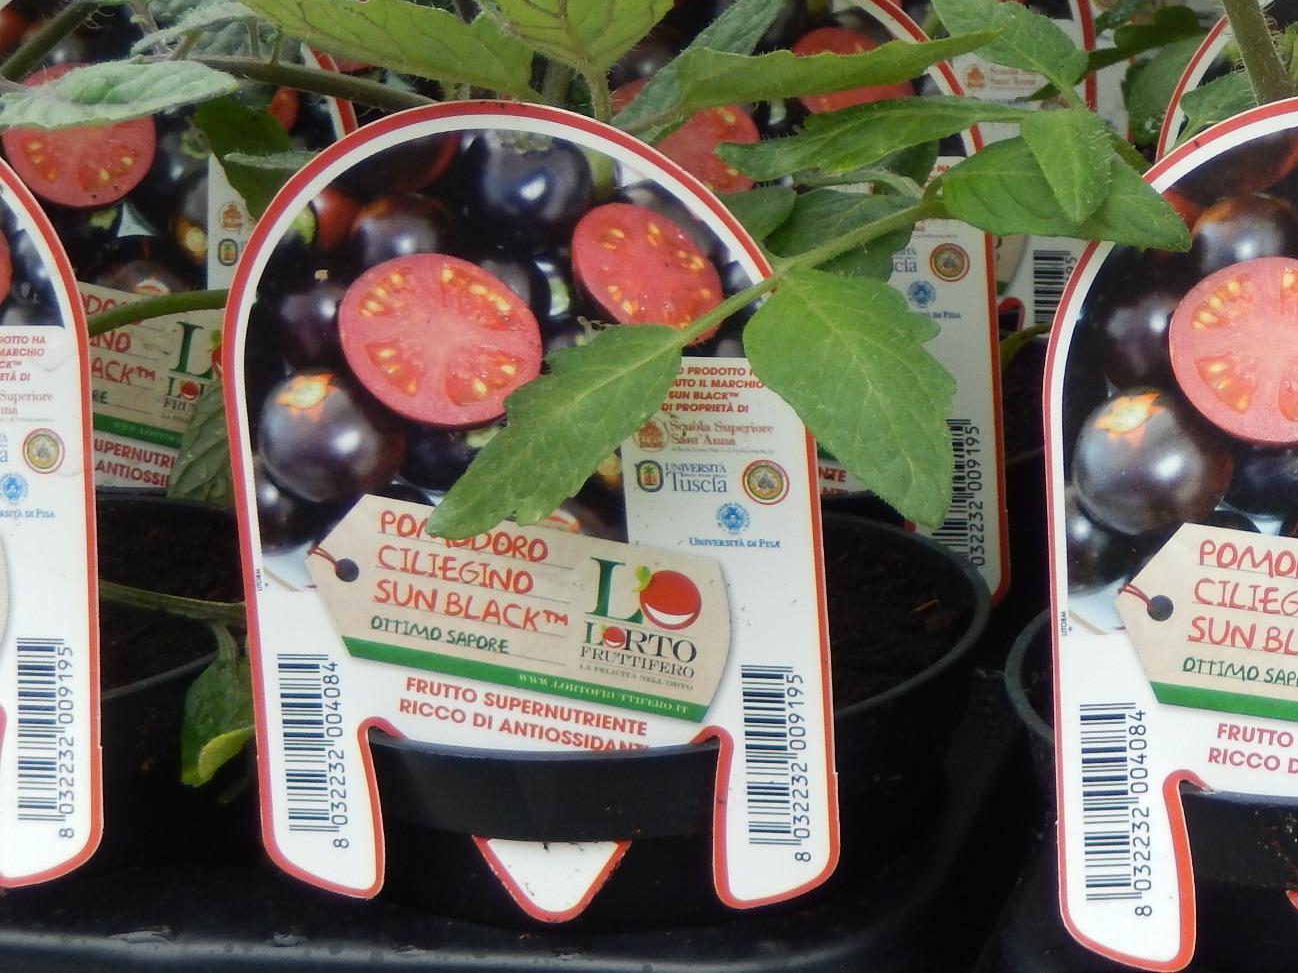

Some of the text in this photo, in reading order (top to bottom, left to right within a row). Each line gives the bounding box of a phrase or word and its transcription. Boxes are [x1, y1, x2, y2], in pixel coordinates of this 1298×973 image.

[21, 373, 30, 381] DI
[688, 367, 746, 375] PRODOTTO
[711, 380, 764, 388] MARCHIO
[662, 402, 748, 413] DI PROPRIETÀ DI
[715, 421, 774, 435] Superiore
[965, 425, 982, 491] 009195
[665, 472, 728, 493] Tuscia
[380, 510, 548, 562] PODORO
[377, 544, 534, 595] CILIEGINO
[373, 578, 438, 611] SUN
[371, 615, 511, 654] OTTIMO SAPORE
[1187, 615, 1257, 648] SUN
[580, 645, 695, 679] FRUTTIFERO
[1182, 656, 1260, 682] OTTIMO
[399, 698, 467, 724] RICCO
[472, 712, 493, 729] DI
[405, 676, 648, 736] FRUTTO SUPERNUTRIENTE
[58, 646, 74, 838] 8 032232 009195
[1216, 722, 1294, 748] FRUTTO
[322, 661, 350, 849] 8 032232 004084
[786, 673, 812, 862] 8 032232 009195
[1208, 747, 1281, 771] RICCO
[1128, 710, 1153, 917] 8 032232 004084
